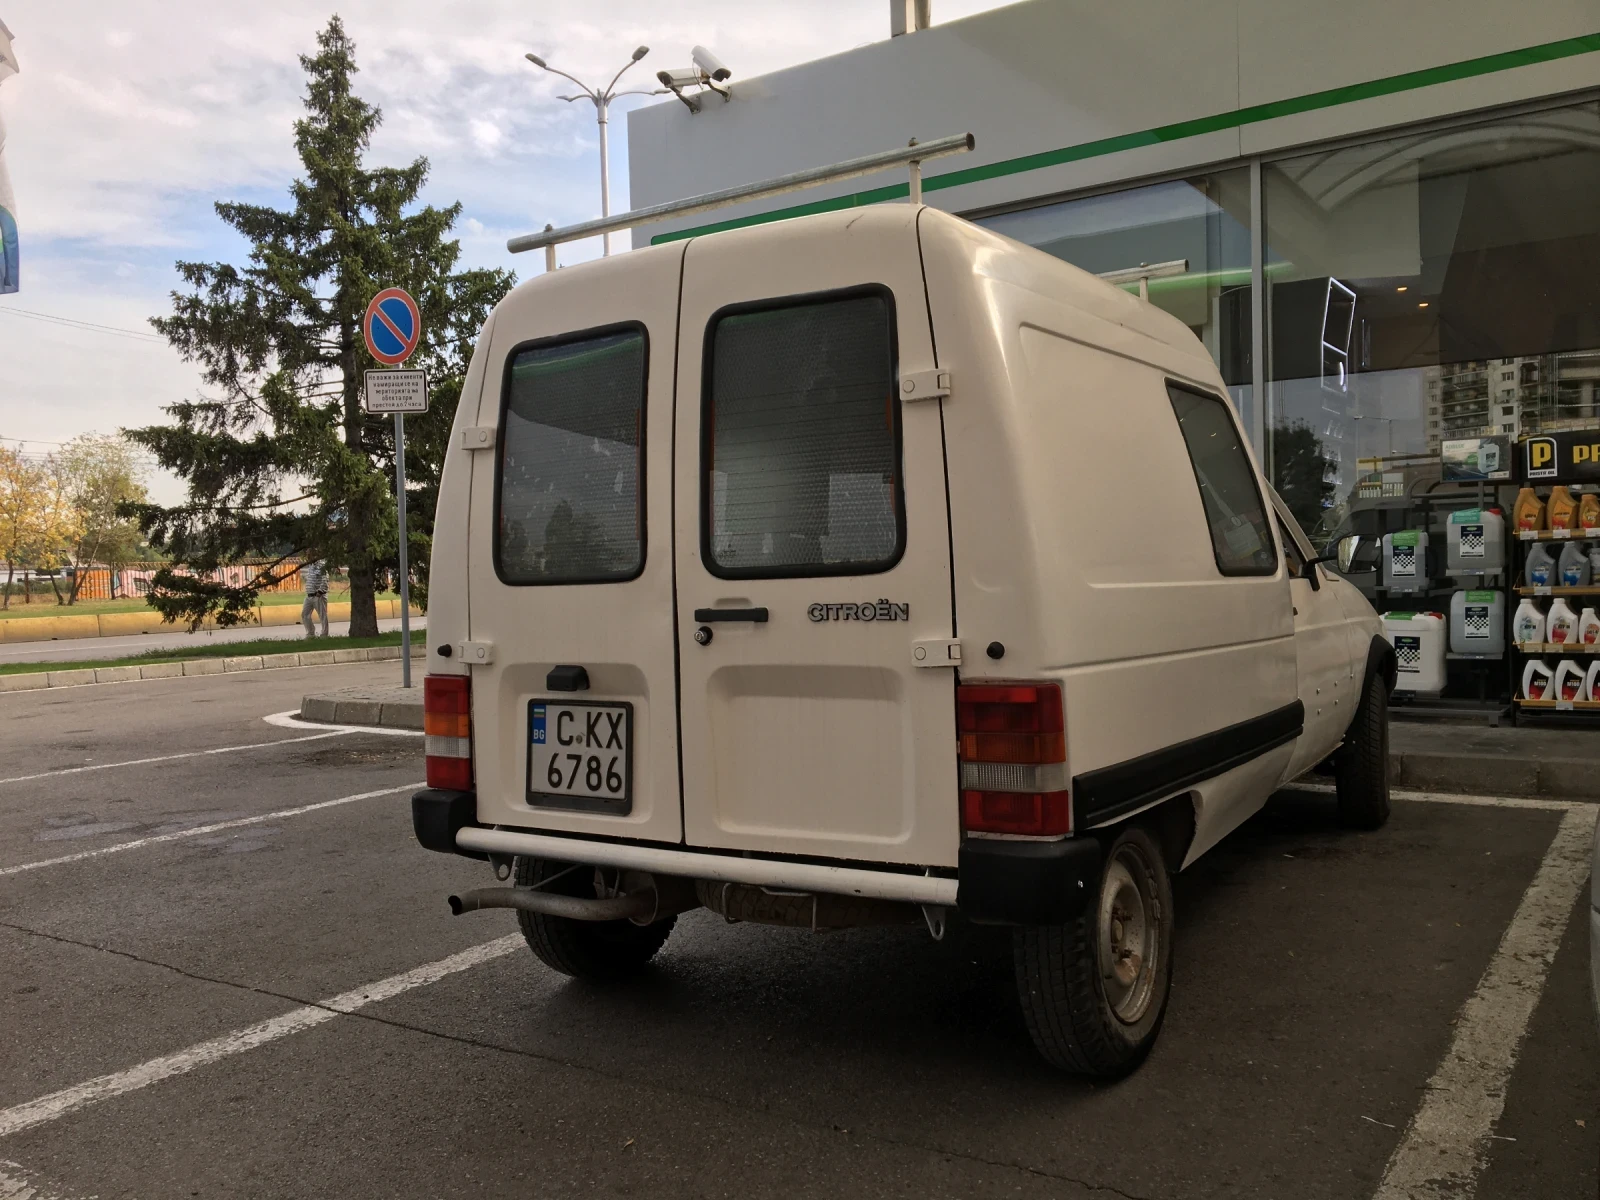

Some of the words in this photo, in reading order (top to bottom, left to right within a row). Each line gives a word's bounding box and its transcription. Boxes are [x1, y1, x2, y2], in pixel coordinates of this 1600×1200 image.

[808, 598, 909, 622] CITROËN
[533, 729, 545, 740] BG
[557, 710, 575, 746] C
[585, 711, 624, 750] KX
[547, 752, 623, 793] 6786
